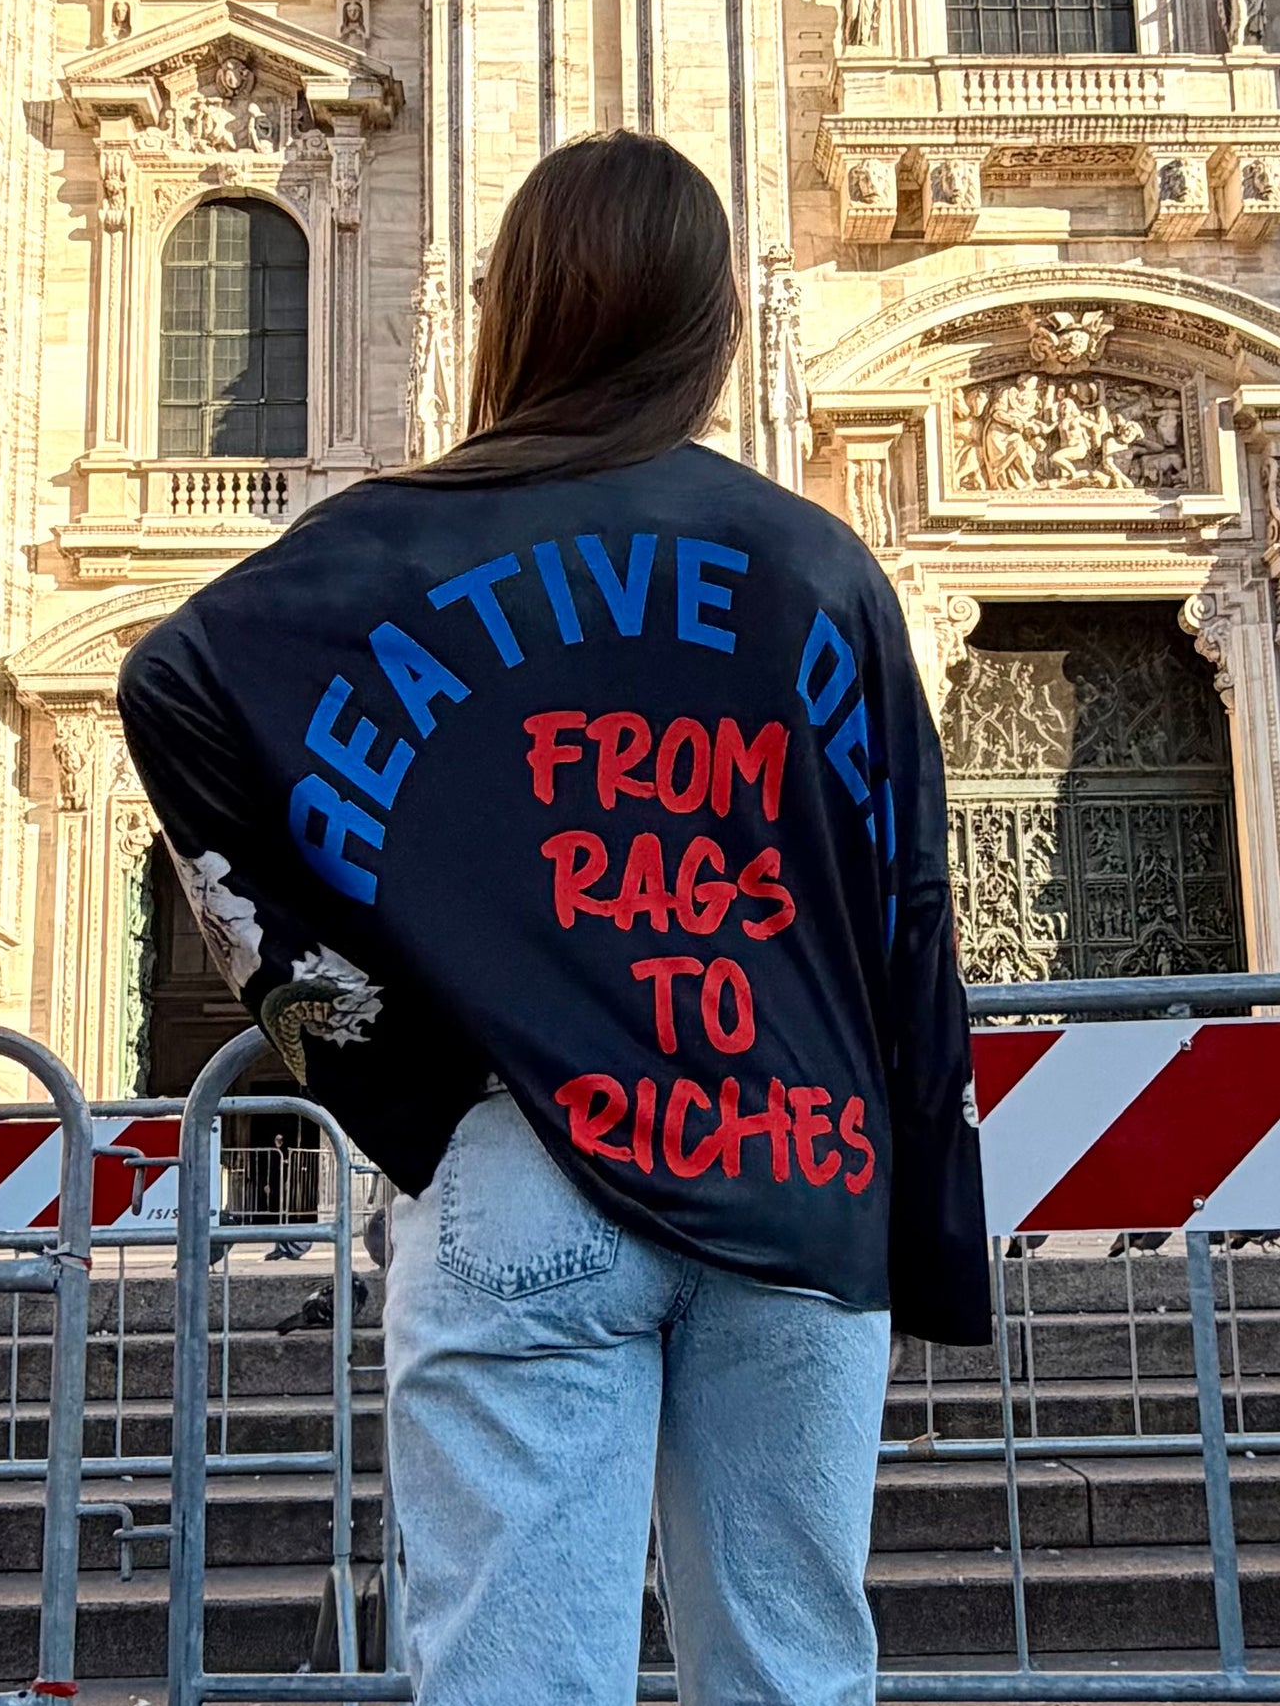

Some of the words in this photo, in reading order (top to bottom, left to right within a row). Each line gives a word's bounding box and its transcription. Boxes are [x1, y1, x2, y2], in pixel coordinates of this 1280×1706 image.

[288, 533, 749, 905] REATIVE
[523, 710, 788, 821] FROM
[540, 830, 796, 941] RAGS
[630, 956, 756, 1054] TO
[554, 1073, 875, 1195] RICHES
